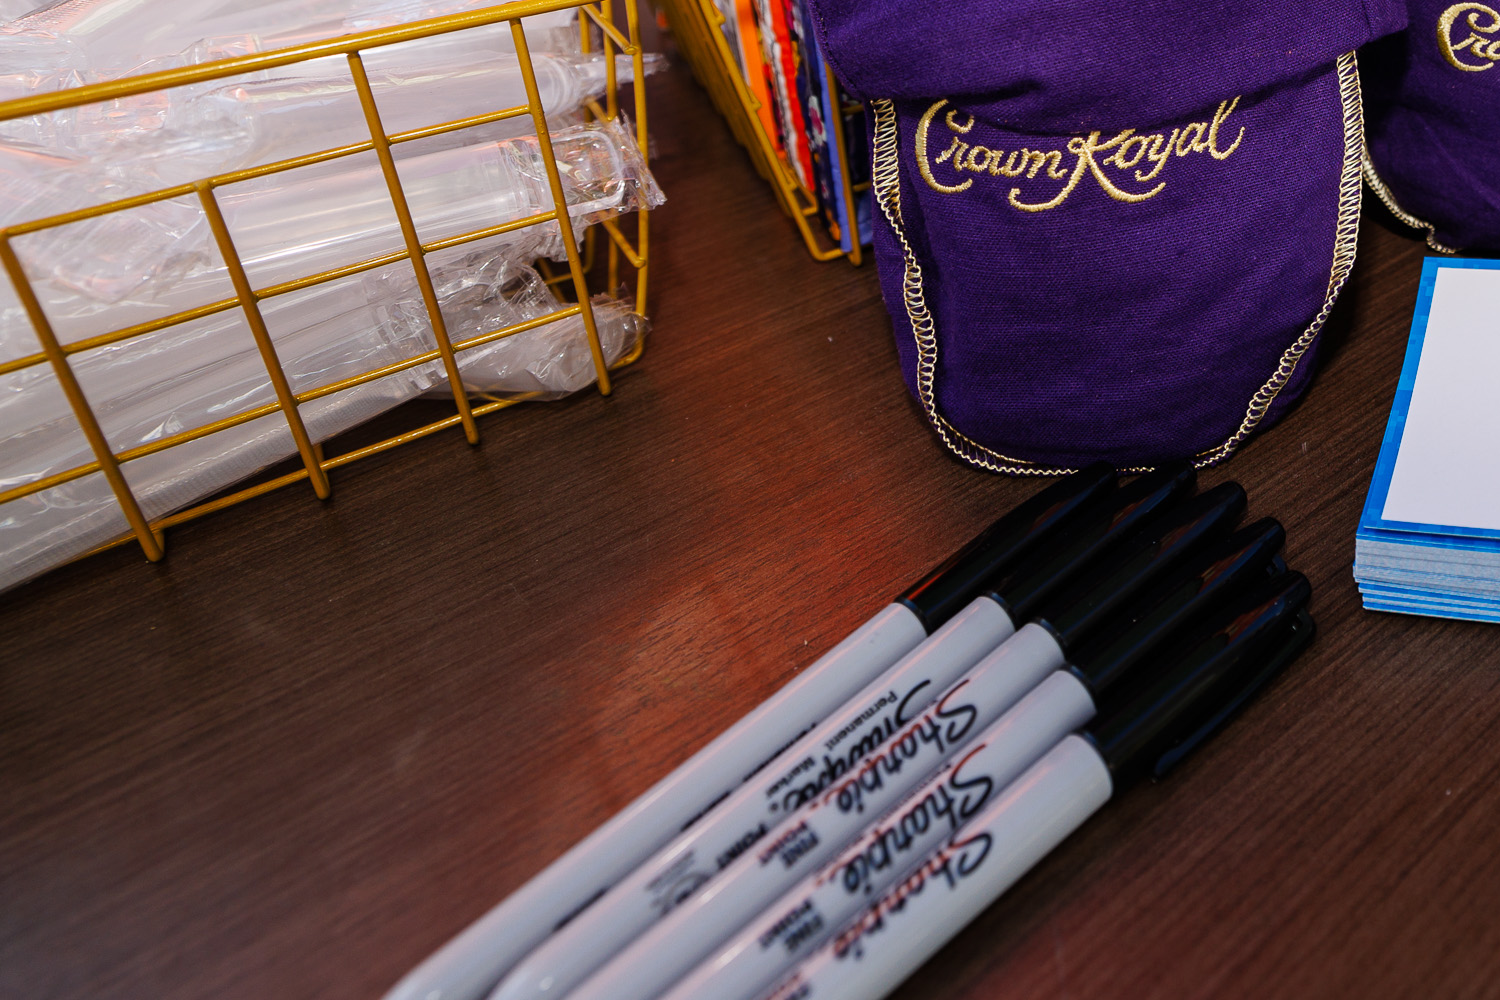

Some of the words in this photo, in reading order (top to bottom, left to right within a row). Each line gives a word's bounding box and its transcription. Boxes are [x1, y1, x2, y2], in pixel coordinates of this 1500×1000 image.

[915, 99, 1068, 193] Crown
[1008, 95, 1246, 212] Royal
[767, 757, 816, 798] Marker
[824, 679, 976, 813] Sharpie
[826, 691, 898, 750] Permanent
[782, 832, 819, 867] FINE
[828, 743, 993, 896] Sharpie
[833, 832, 993, 961] Sharpie
